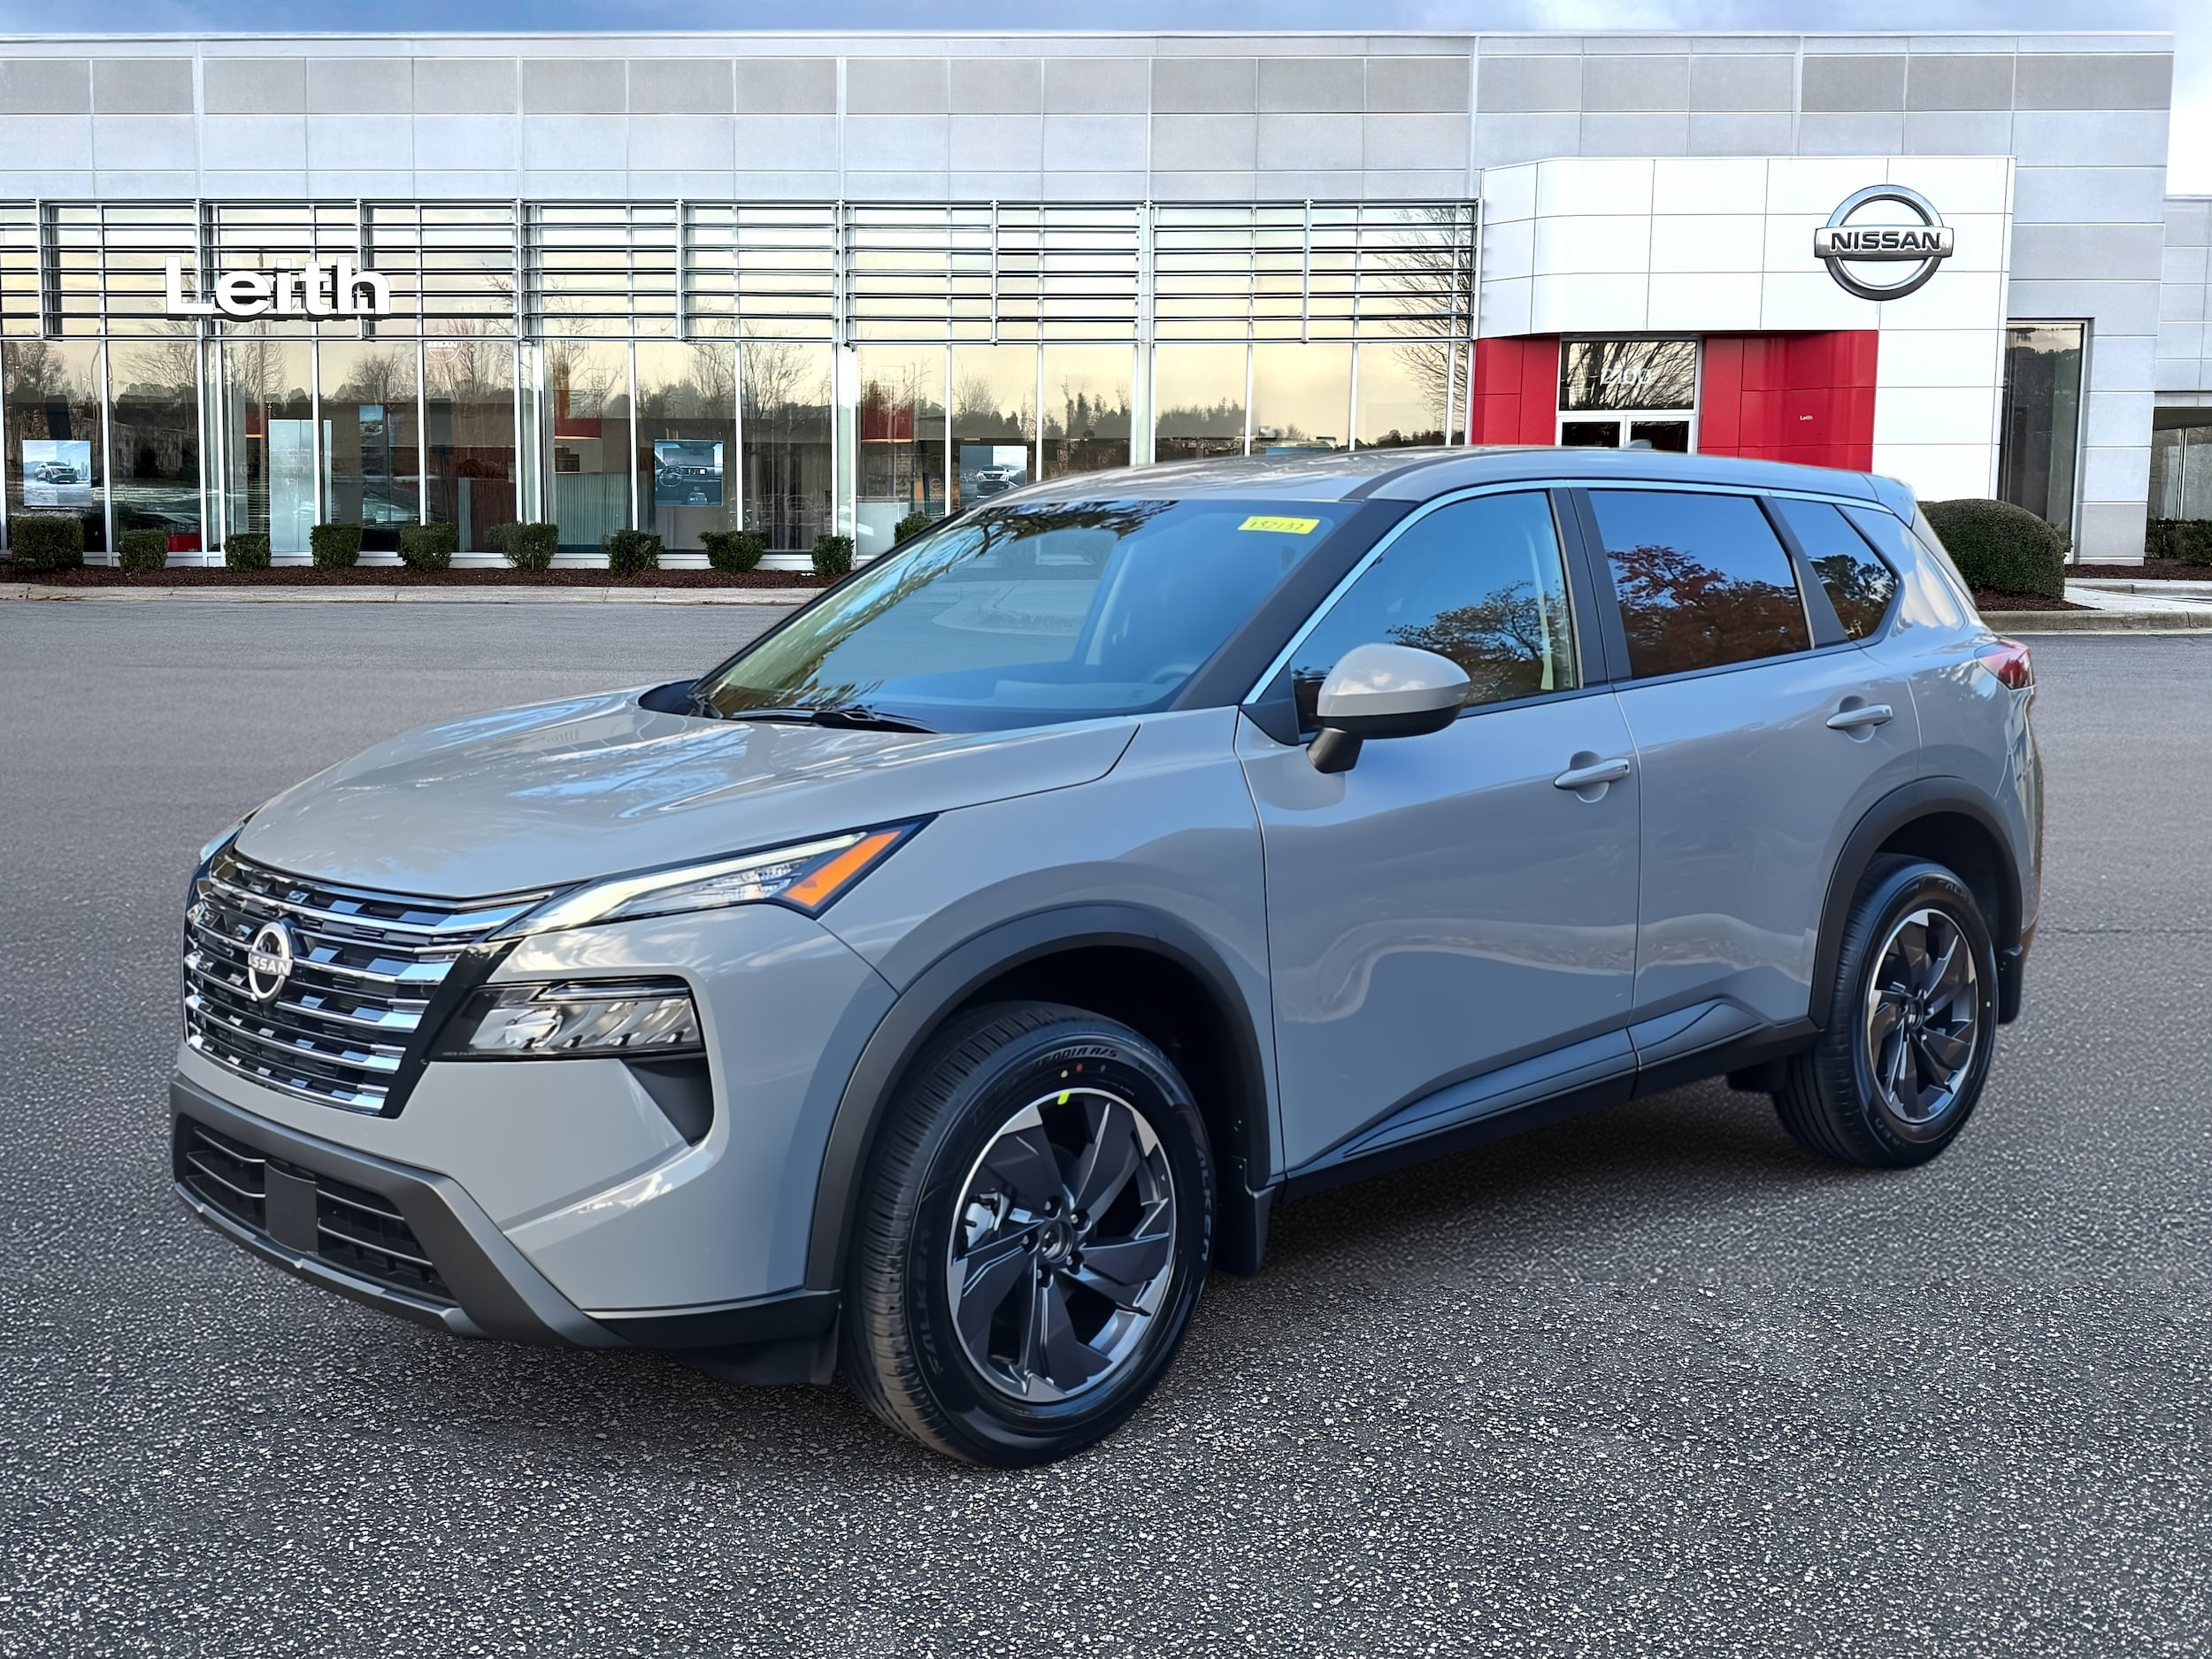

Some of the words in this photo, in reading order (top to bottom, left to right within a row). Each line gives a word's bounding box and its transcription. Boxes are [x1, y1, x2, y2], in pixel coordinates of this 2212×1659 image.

[1831, 231, 1940, 250] NISSAN
[165, 256, 390, 316] Leith
[1602, 367, 1652, 385] 2100
[250, 954, 290, 974] SSAN
[1194, 1147, 1212, 1263] ALKEN
